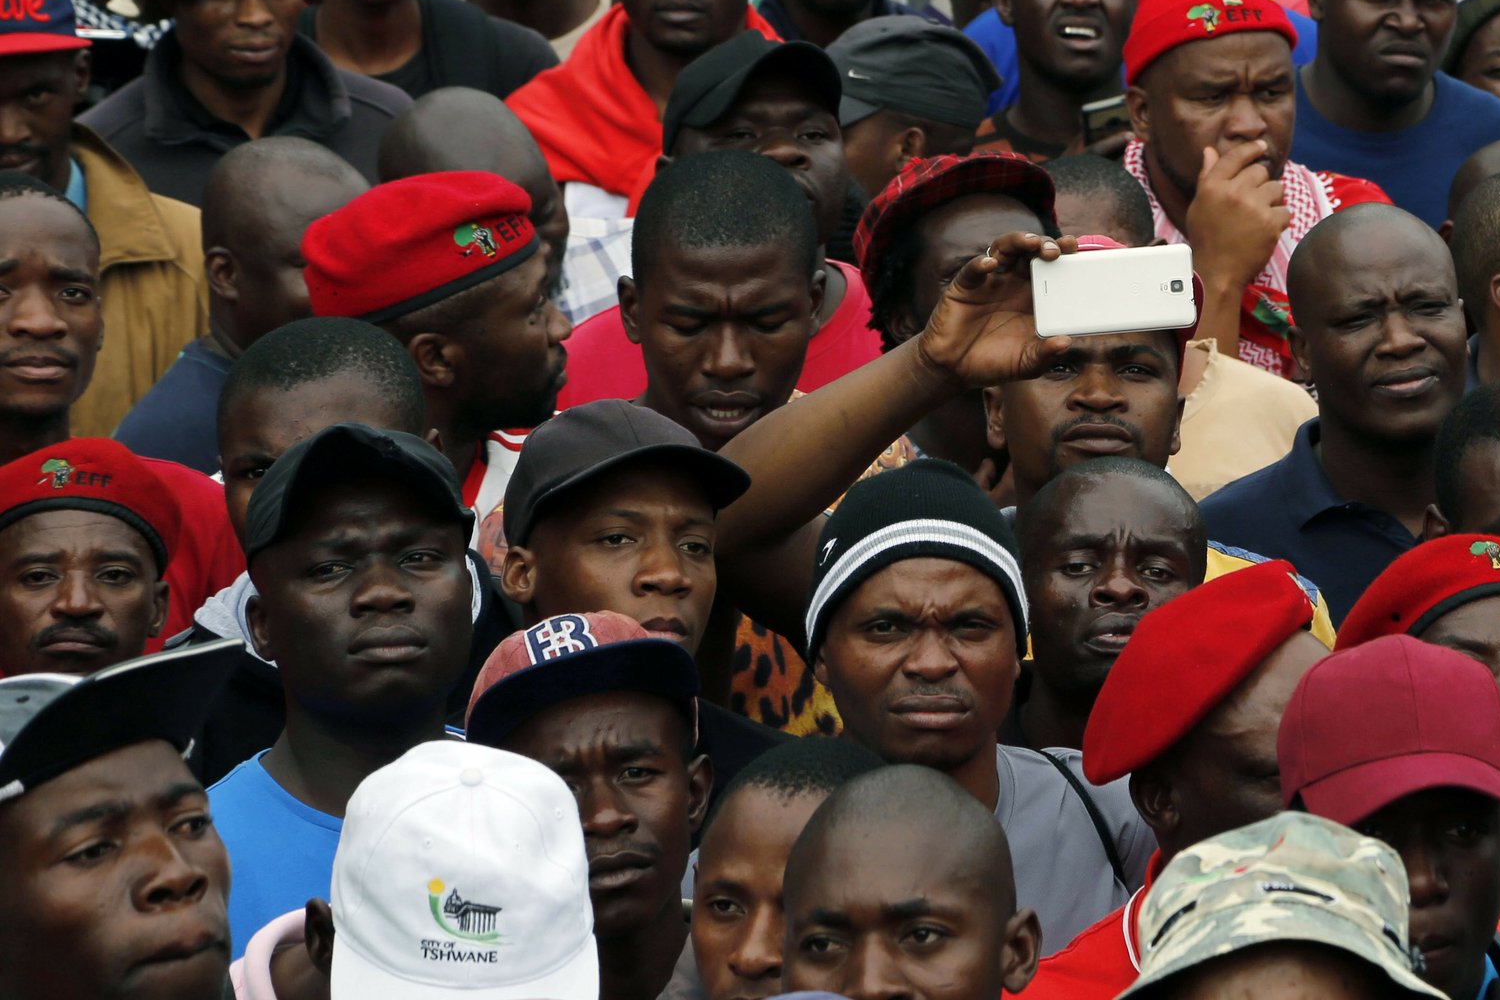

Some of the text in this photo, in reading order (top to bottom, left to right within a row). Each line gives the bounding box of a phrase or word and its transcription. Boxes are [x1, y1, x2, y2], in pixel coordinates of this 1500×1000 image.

[1226, 8, 1262, 22] EFF
[76, 471, 112, 488] EFF
[421, 939, 456, 950] CITY OF
[421, 946, 498, 963] TSHWANE
